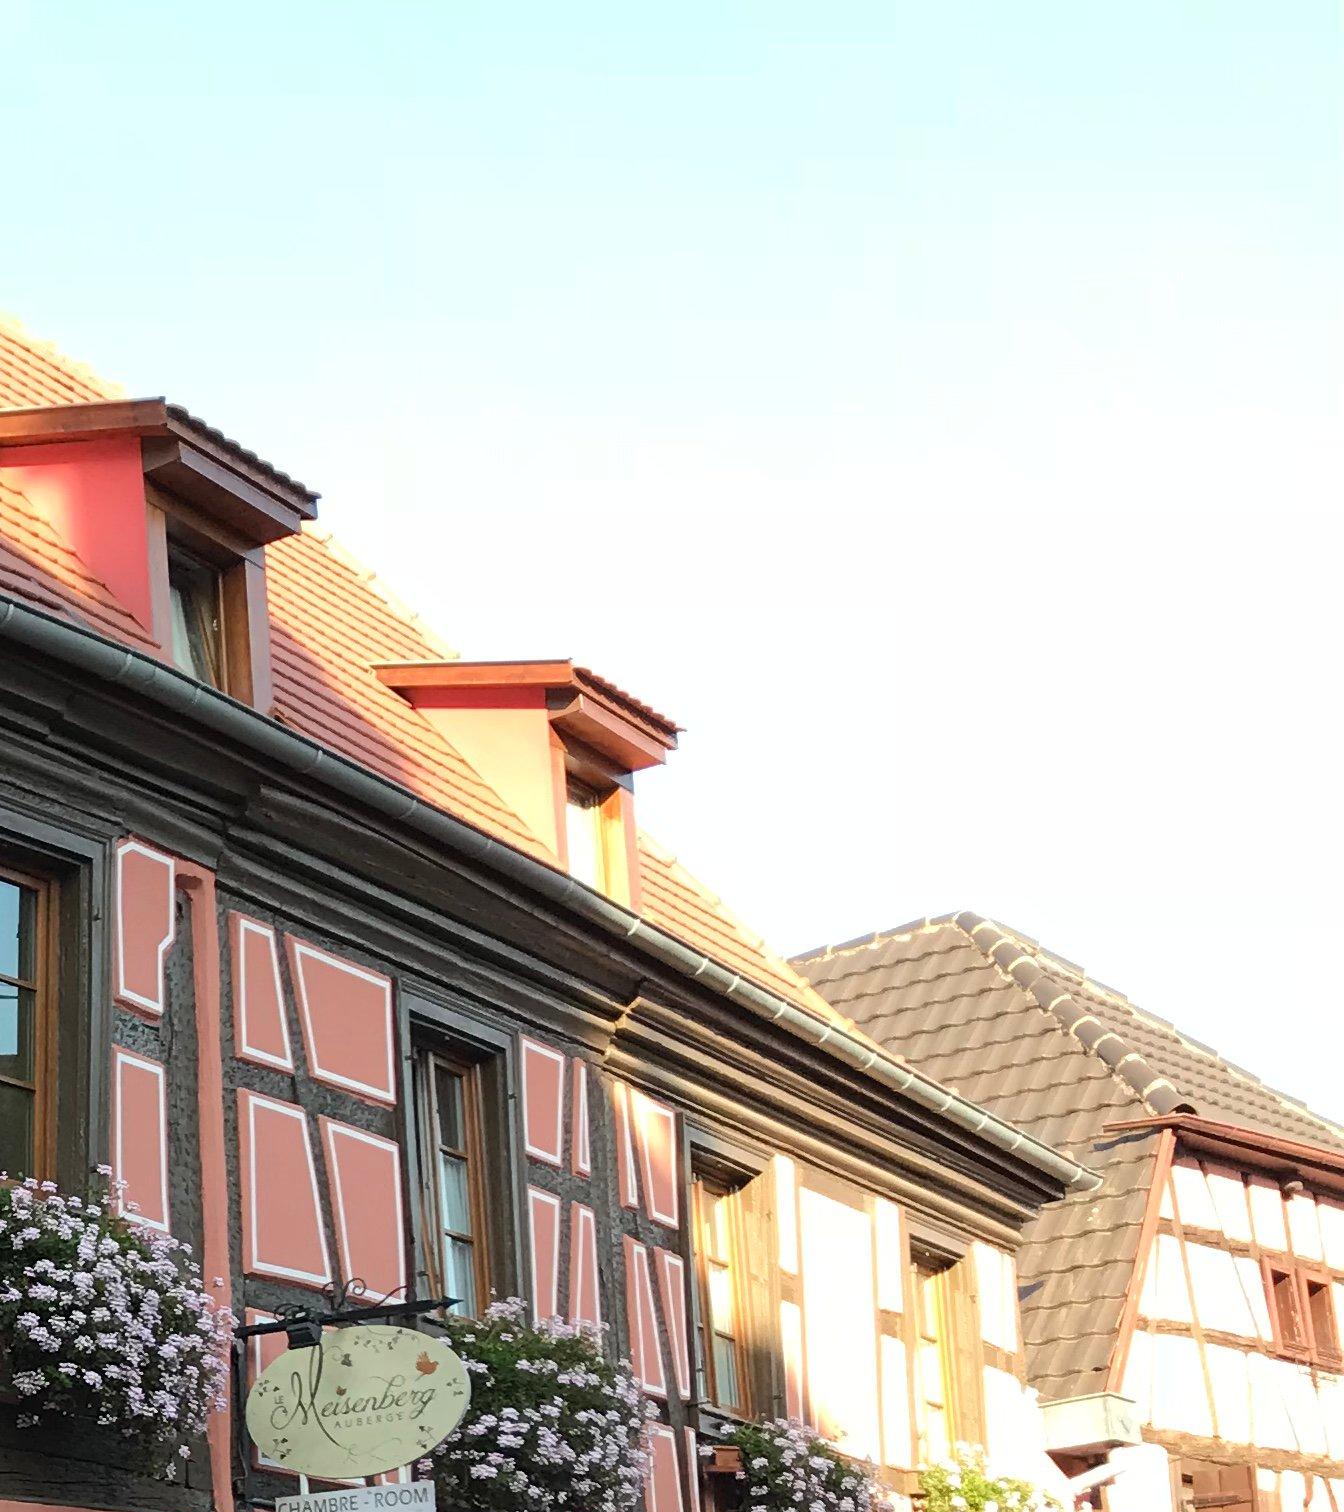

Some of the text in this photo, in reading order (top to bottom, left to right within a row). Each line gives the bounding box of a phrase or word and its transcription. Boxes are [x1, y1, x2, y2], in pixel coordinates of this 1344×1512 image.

[269, 1342, 436, 1451] Meisenberg
[334, 1411, 403, 1430] AUBERGE
[374, 1487, 429, 1509] ROOM
